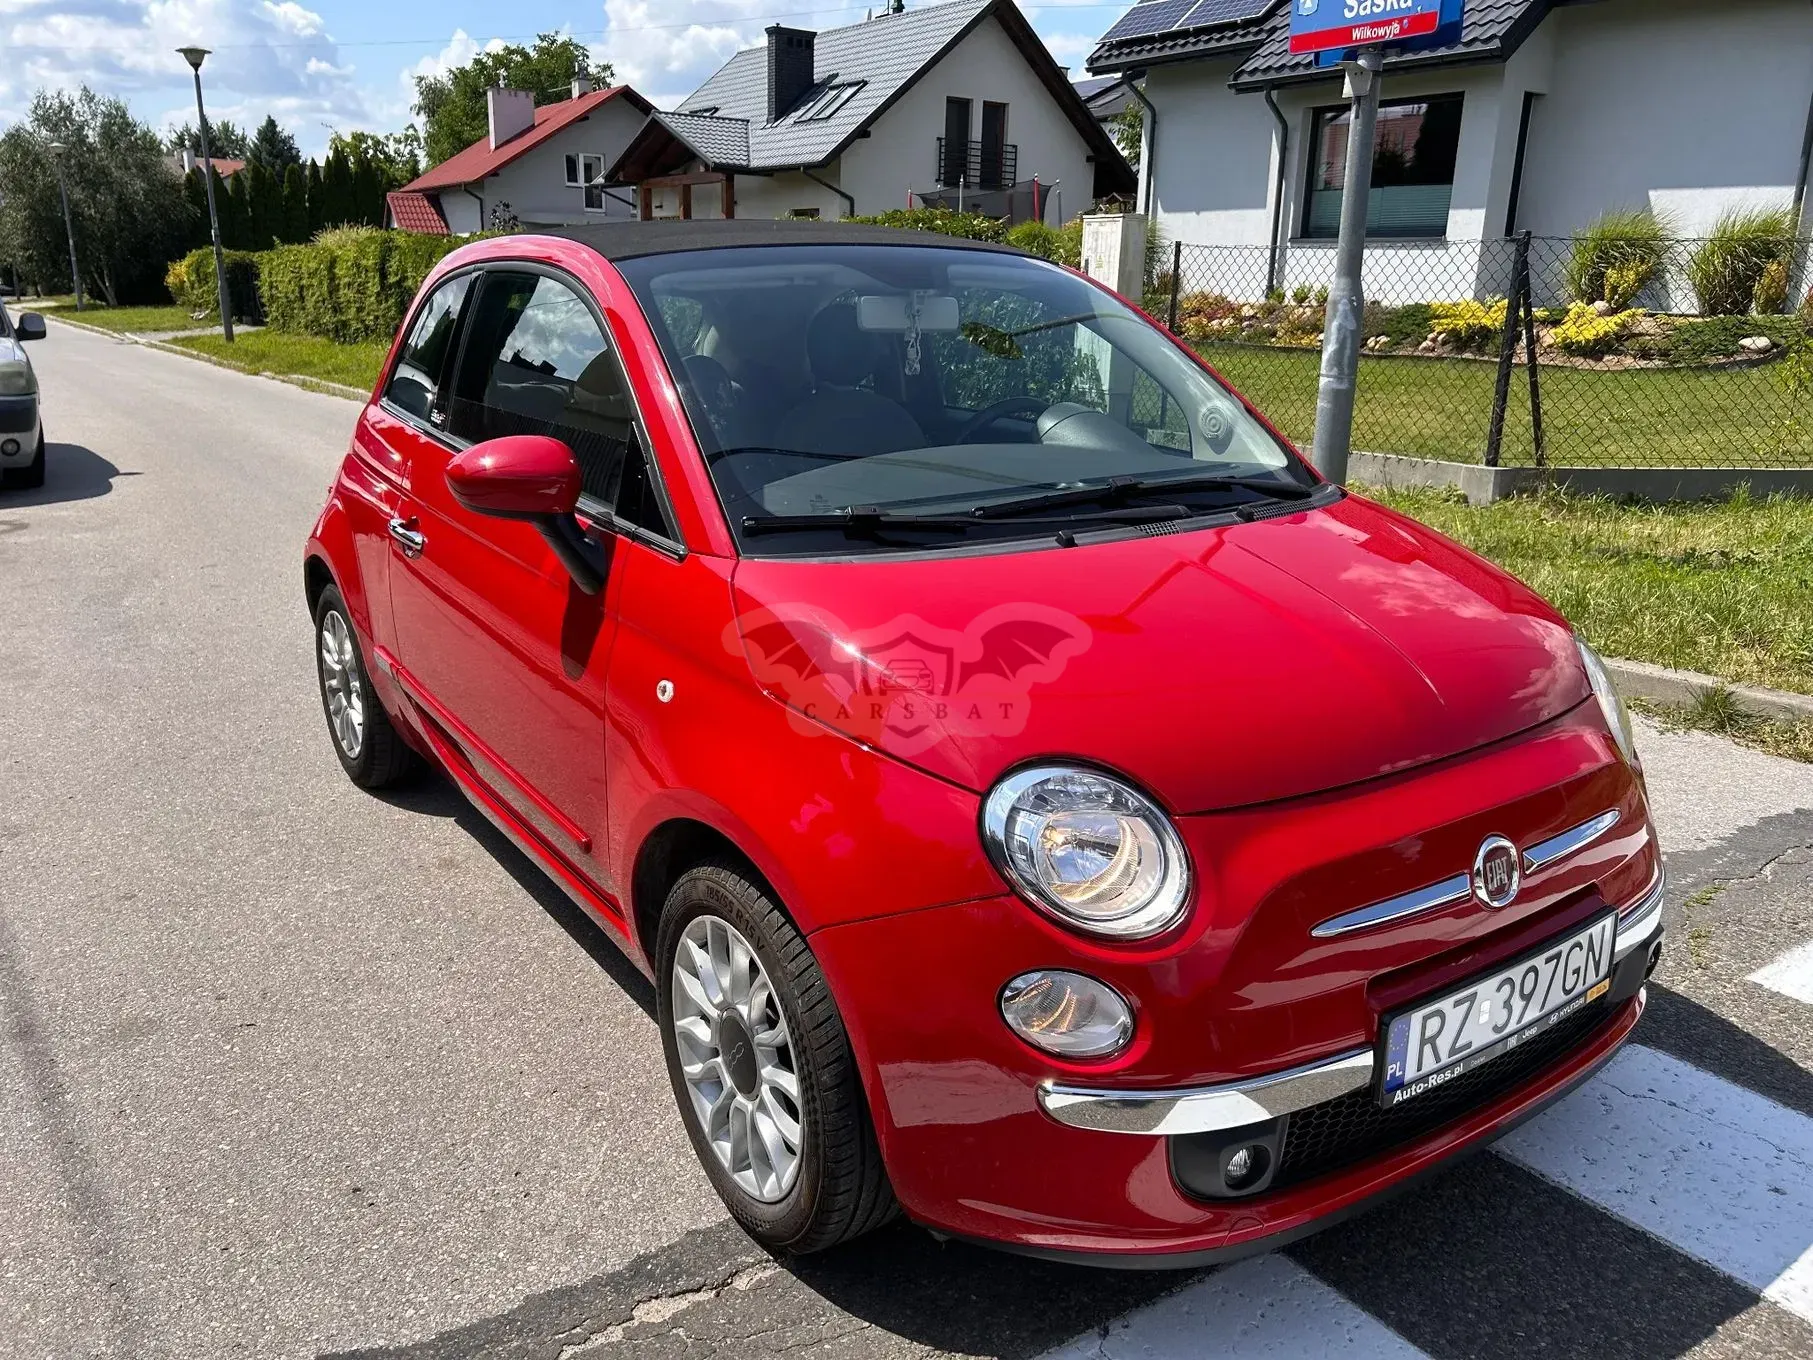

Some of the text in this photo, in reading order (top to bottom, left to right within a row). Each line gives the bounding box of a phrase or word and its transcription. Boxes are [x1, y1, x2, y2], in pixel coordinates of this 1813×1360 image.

[1352, 21, 1400, 40] Wilkowyja
[1486, 856, 1508, 891] FIAT
[1492, 923, 1607, 1035] 397GN
[1387, 1061, 1403, 1081] PL
[1392, 1062, 1464, 1104] Auto-Res.pl
